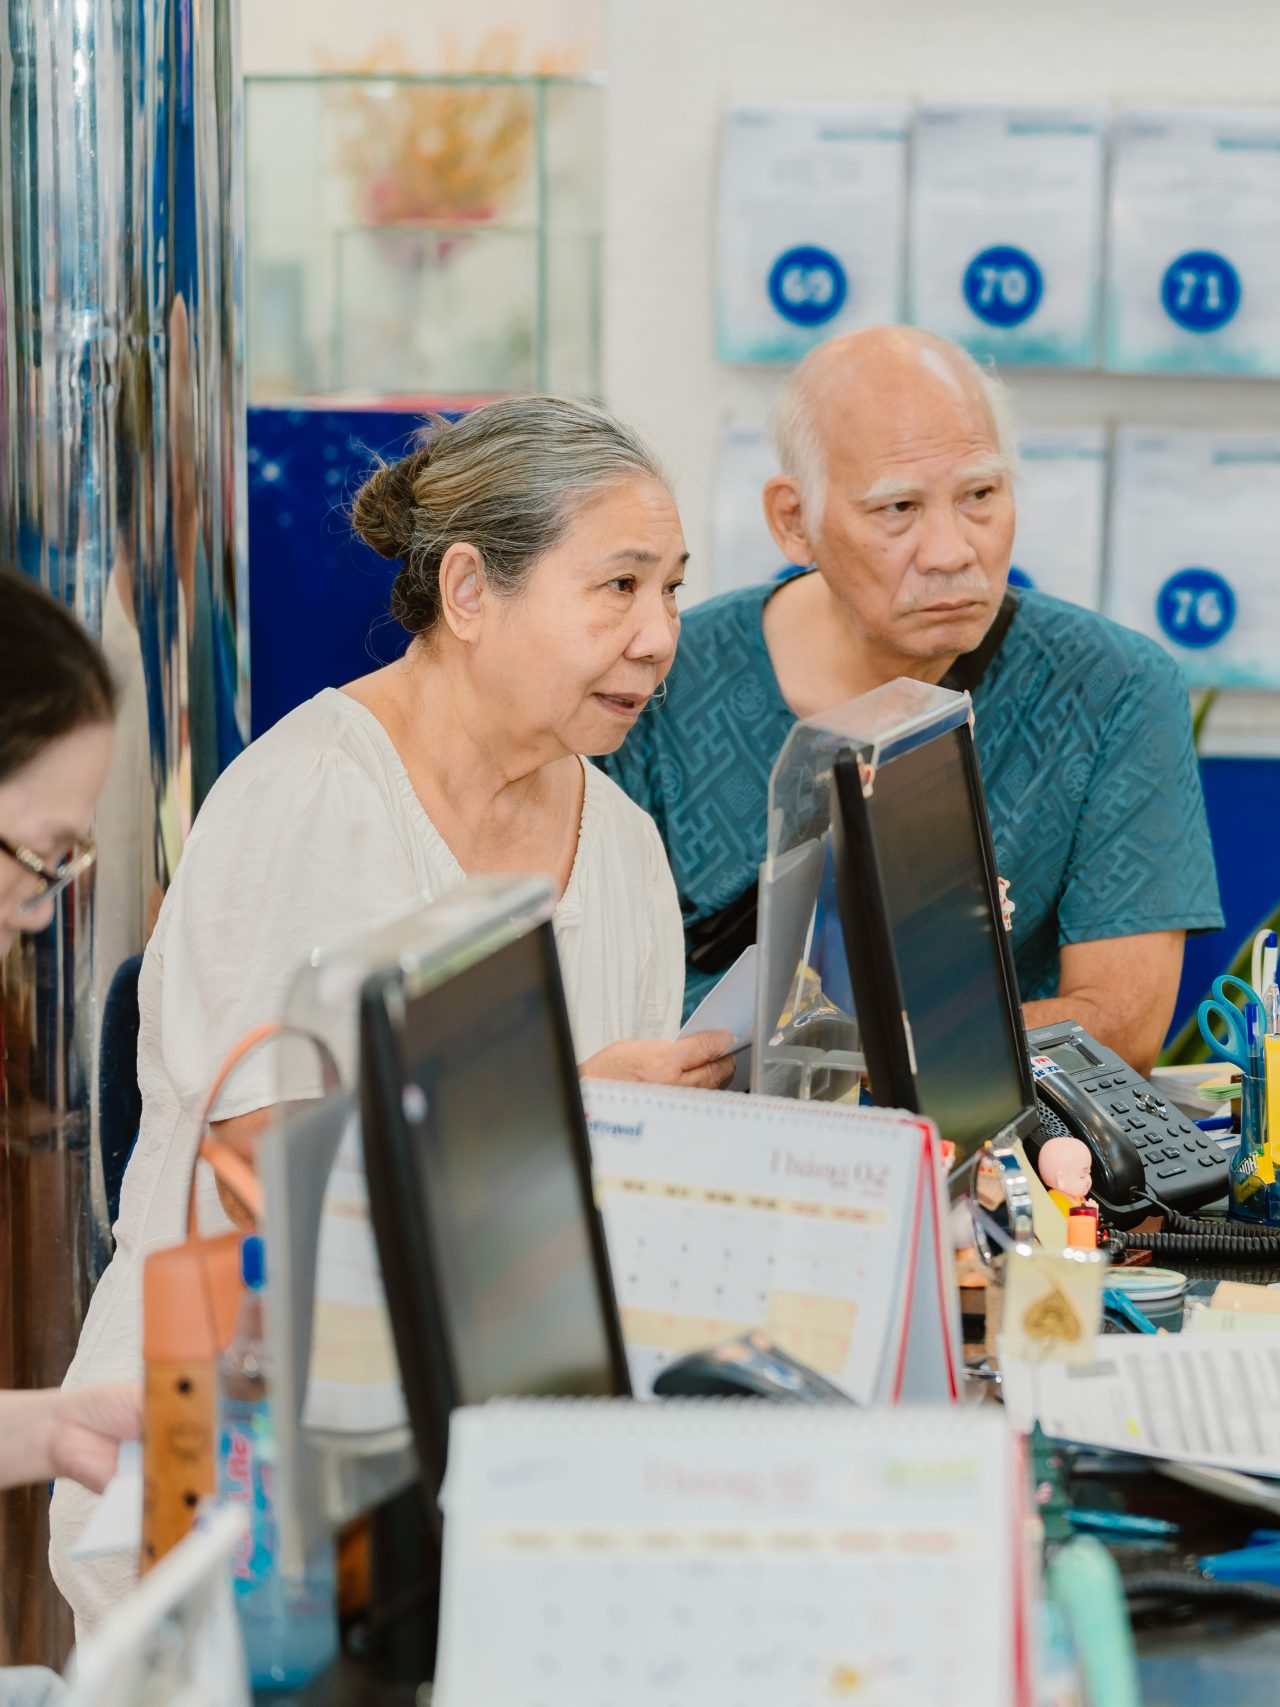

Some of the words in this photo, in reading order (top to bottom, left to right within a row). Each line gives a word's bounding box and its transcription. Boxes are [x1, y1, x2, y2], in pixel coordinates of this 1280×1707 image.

[781, 266, 834, 304] 69
[979, 267, 1028, 304] 70
[1178, 272, 1221, 309] 71
[1173, 589, 1224, 629] 76
